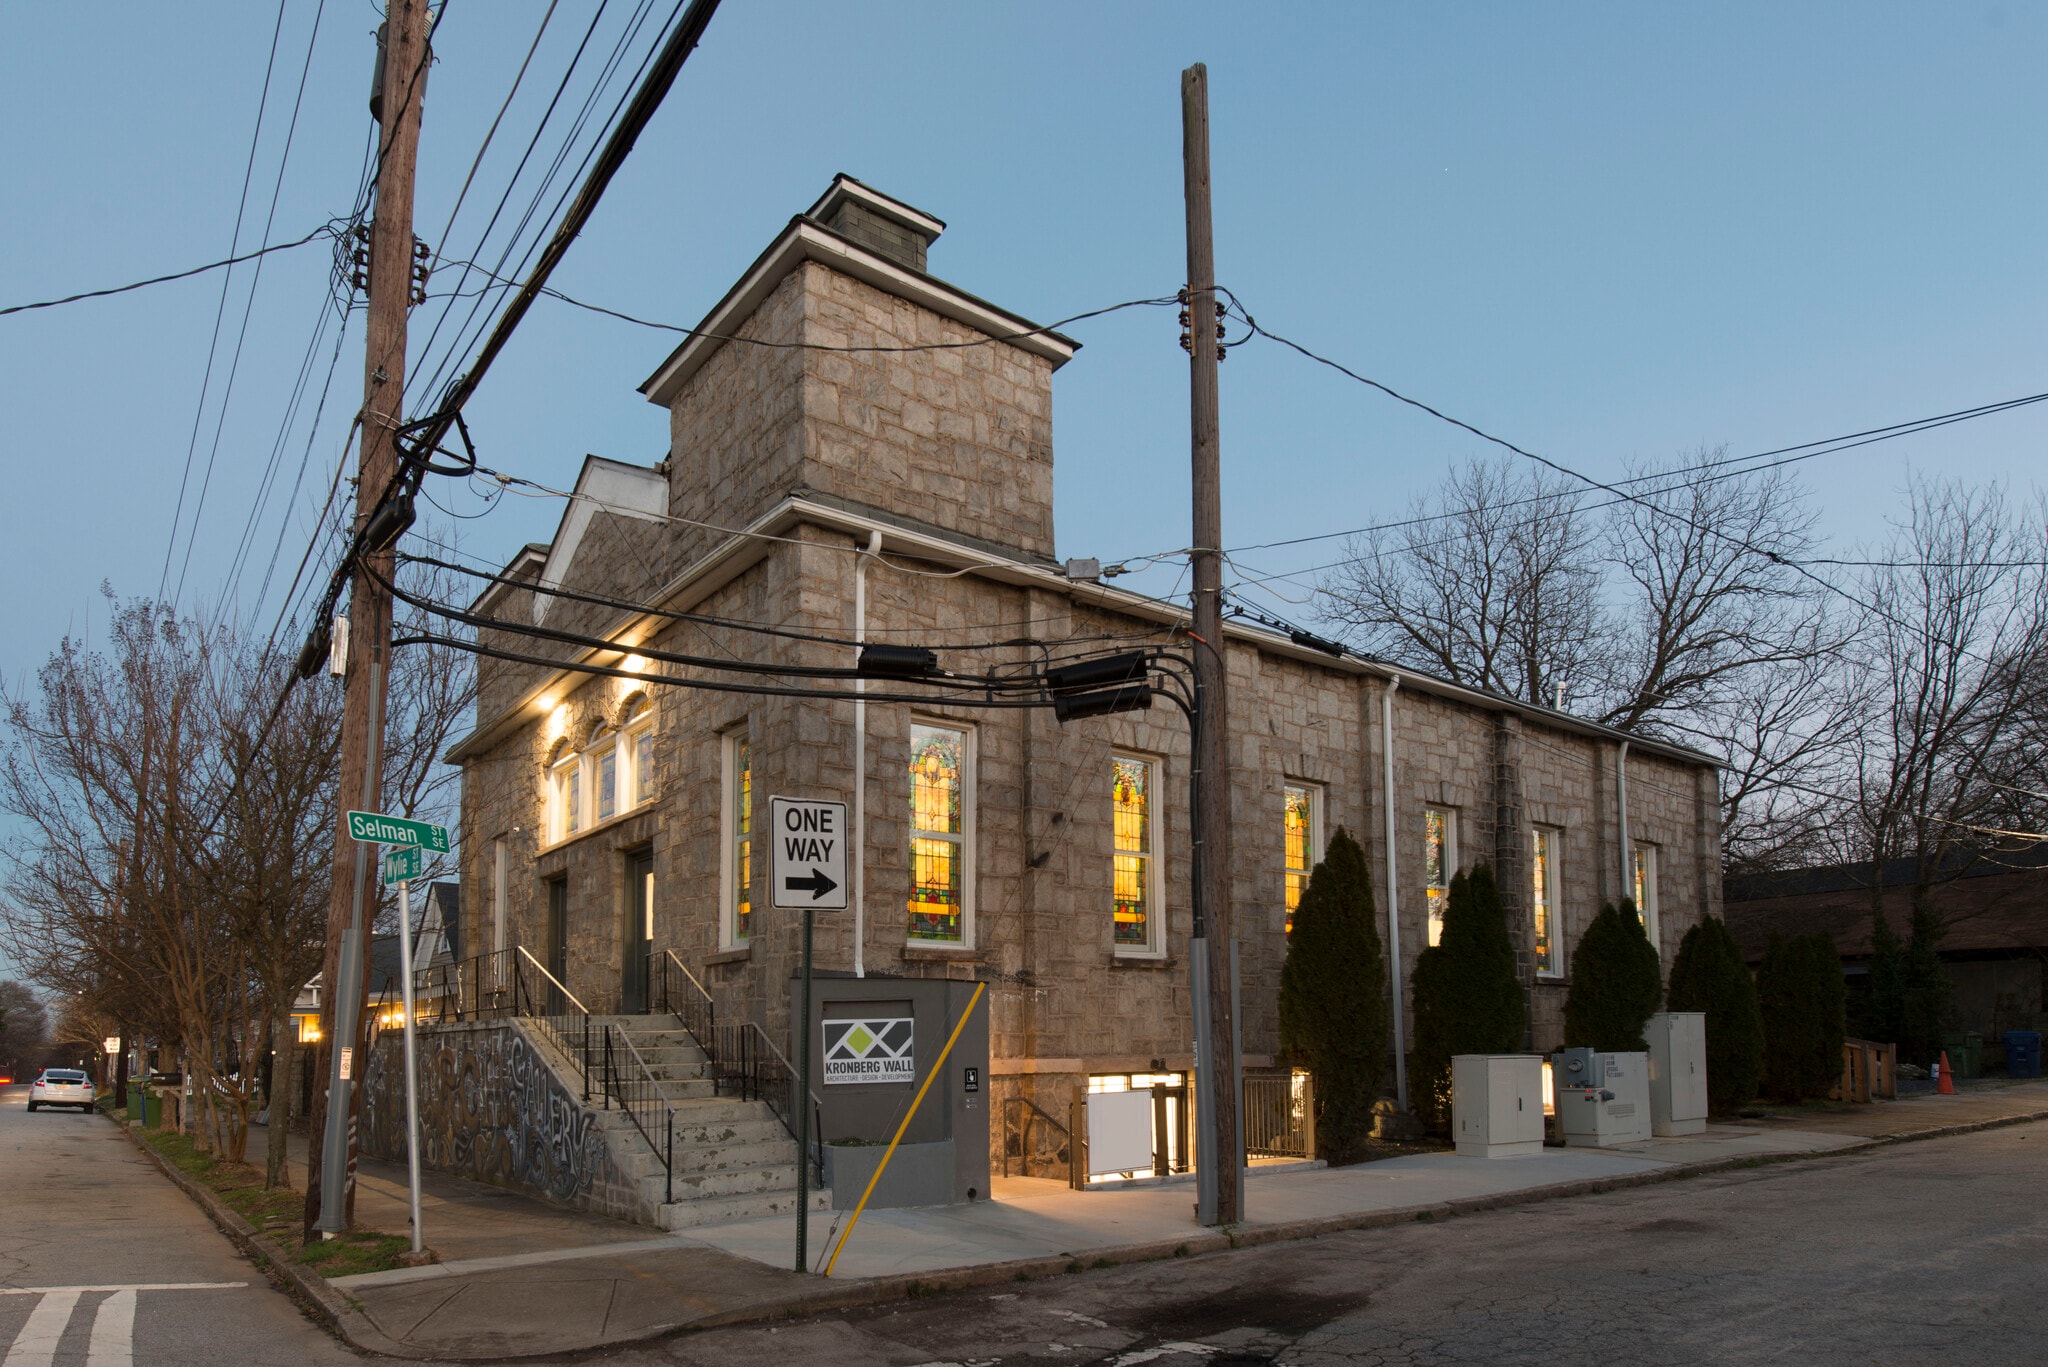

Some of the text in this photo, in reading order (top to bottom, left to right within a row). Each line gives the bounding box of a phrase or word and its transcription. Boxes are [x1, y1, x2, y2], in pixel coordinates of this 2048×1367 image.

[786, 808, 833, 833] ONE
[354, 816, 418, 843] Selman
[431, 826, 443, 837] ST
[432, 838, 445, 848] SE
[785, 837, 834, 862] WAY
[412, 847, 420, 860] ST
[386, 853, 408, 881] Wylie
[412, 861, 420, 874] SE
[826, 1060, 913, 1074] KRONBERG WALL
[826, 1074, 859, 1082] ARCHITECTURE
[881, 1073, 914, 1081] DEVELOPMENT
